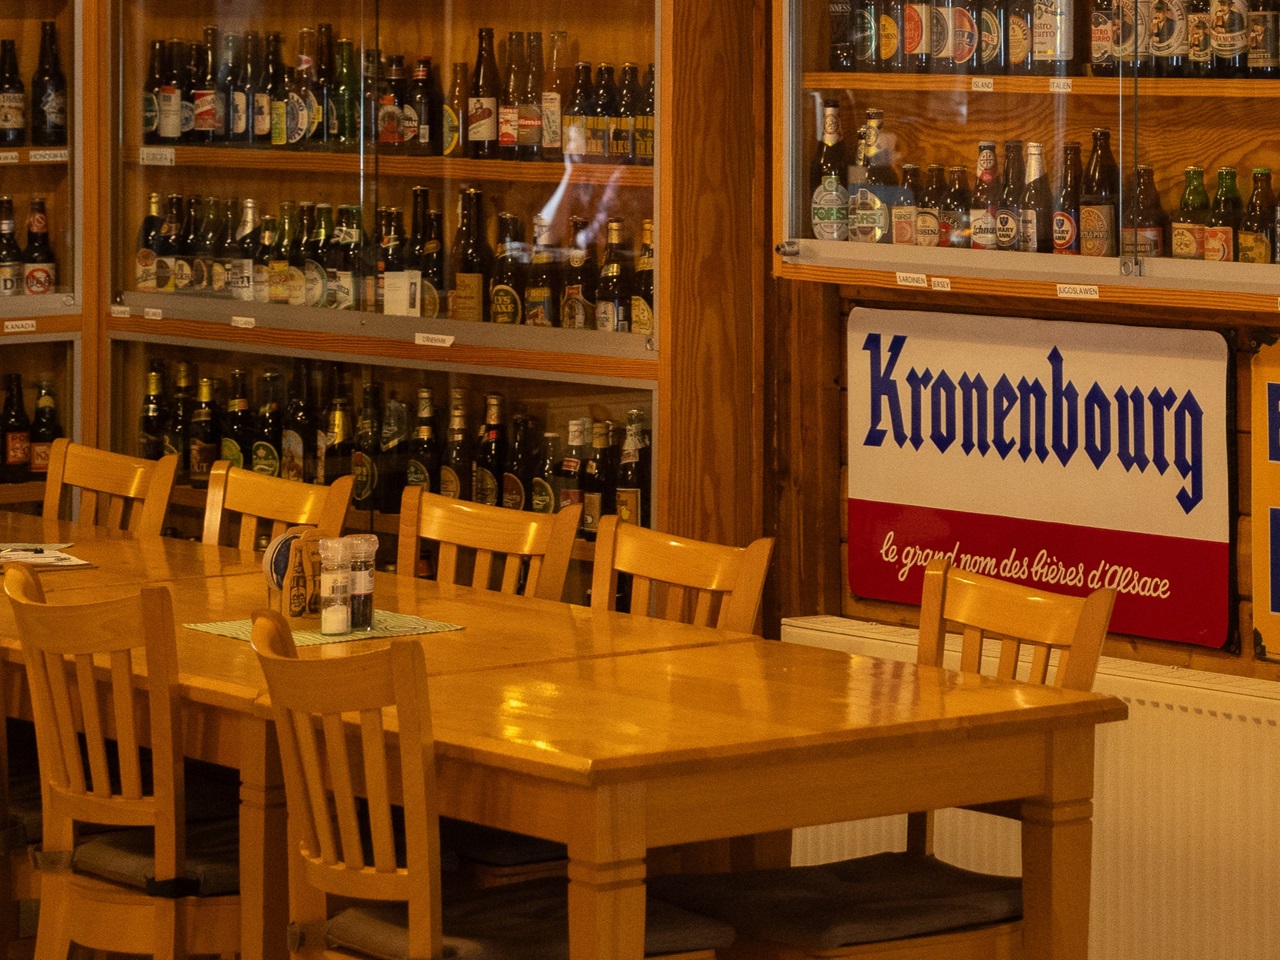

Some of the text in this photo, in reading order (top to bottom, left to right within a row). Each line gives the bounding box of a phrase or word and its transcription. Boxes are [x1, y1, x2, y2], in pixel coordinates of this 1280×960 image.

[1057, 284, 1099, 297] JUGOSLAWIEN
[5, 323, 36, 333] KANADA
[863, 332, 1204, 515] Kronenbourg
[880, 531, 1171, 599] le grand nom des bières d'Alsace
